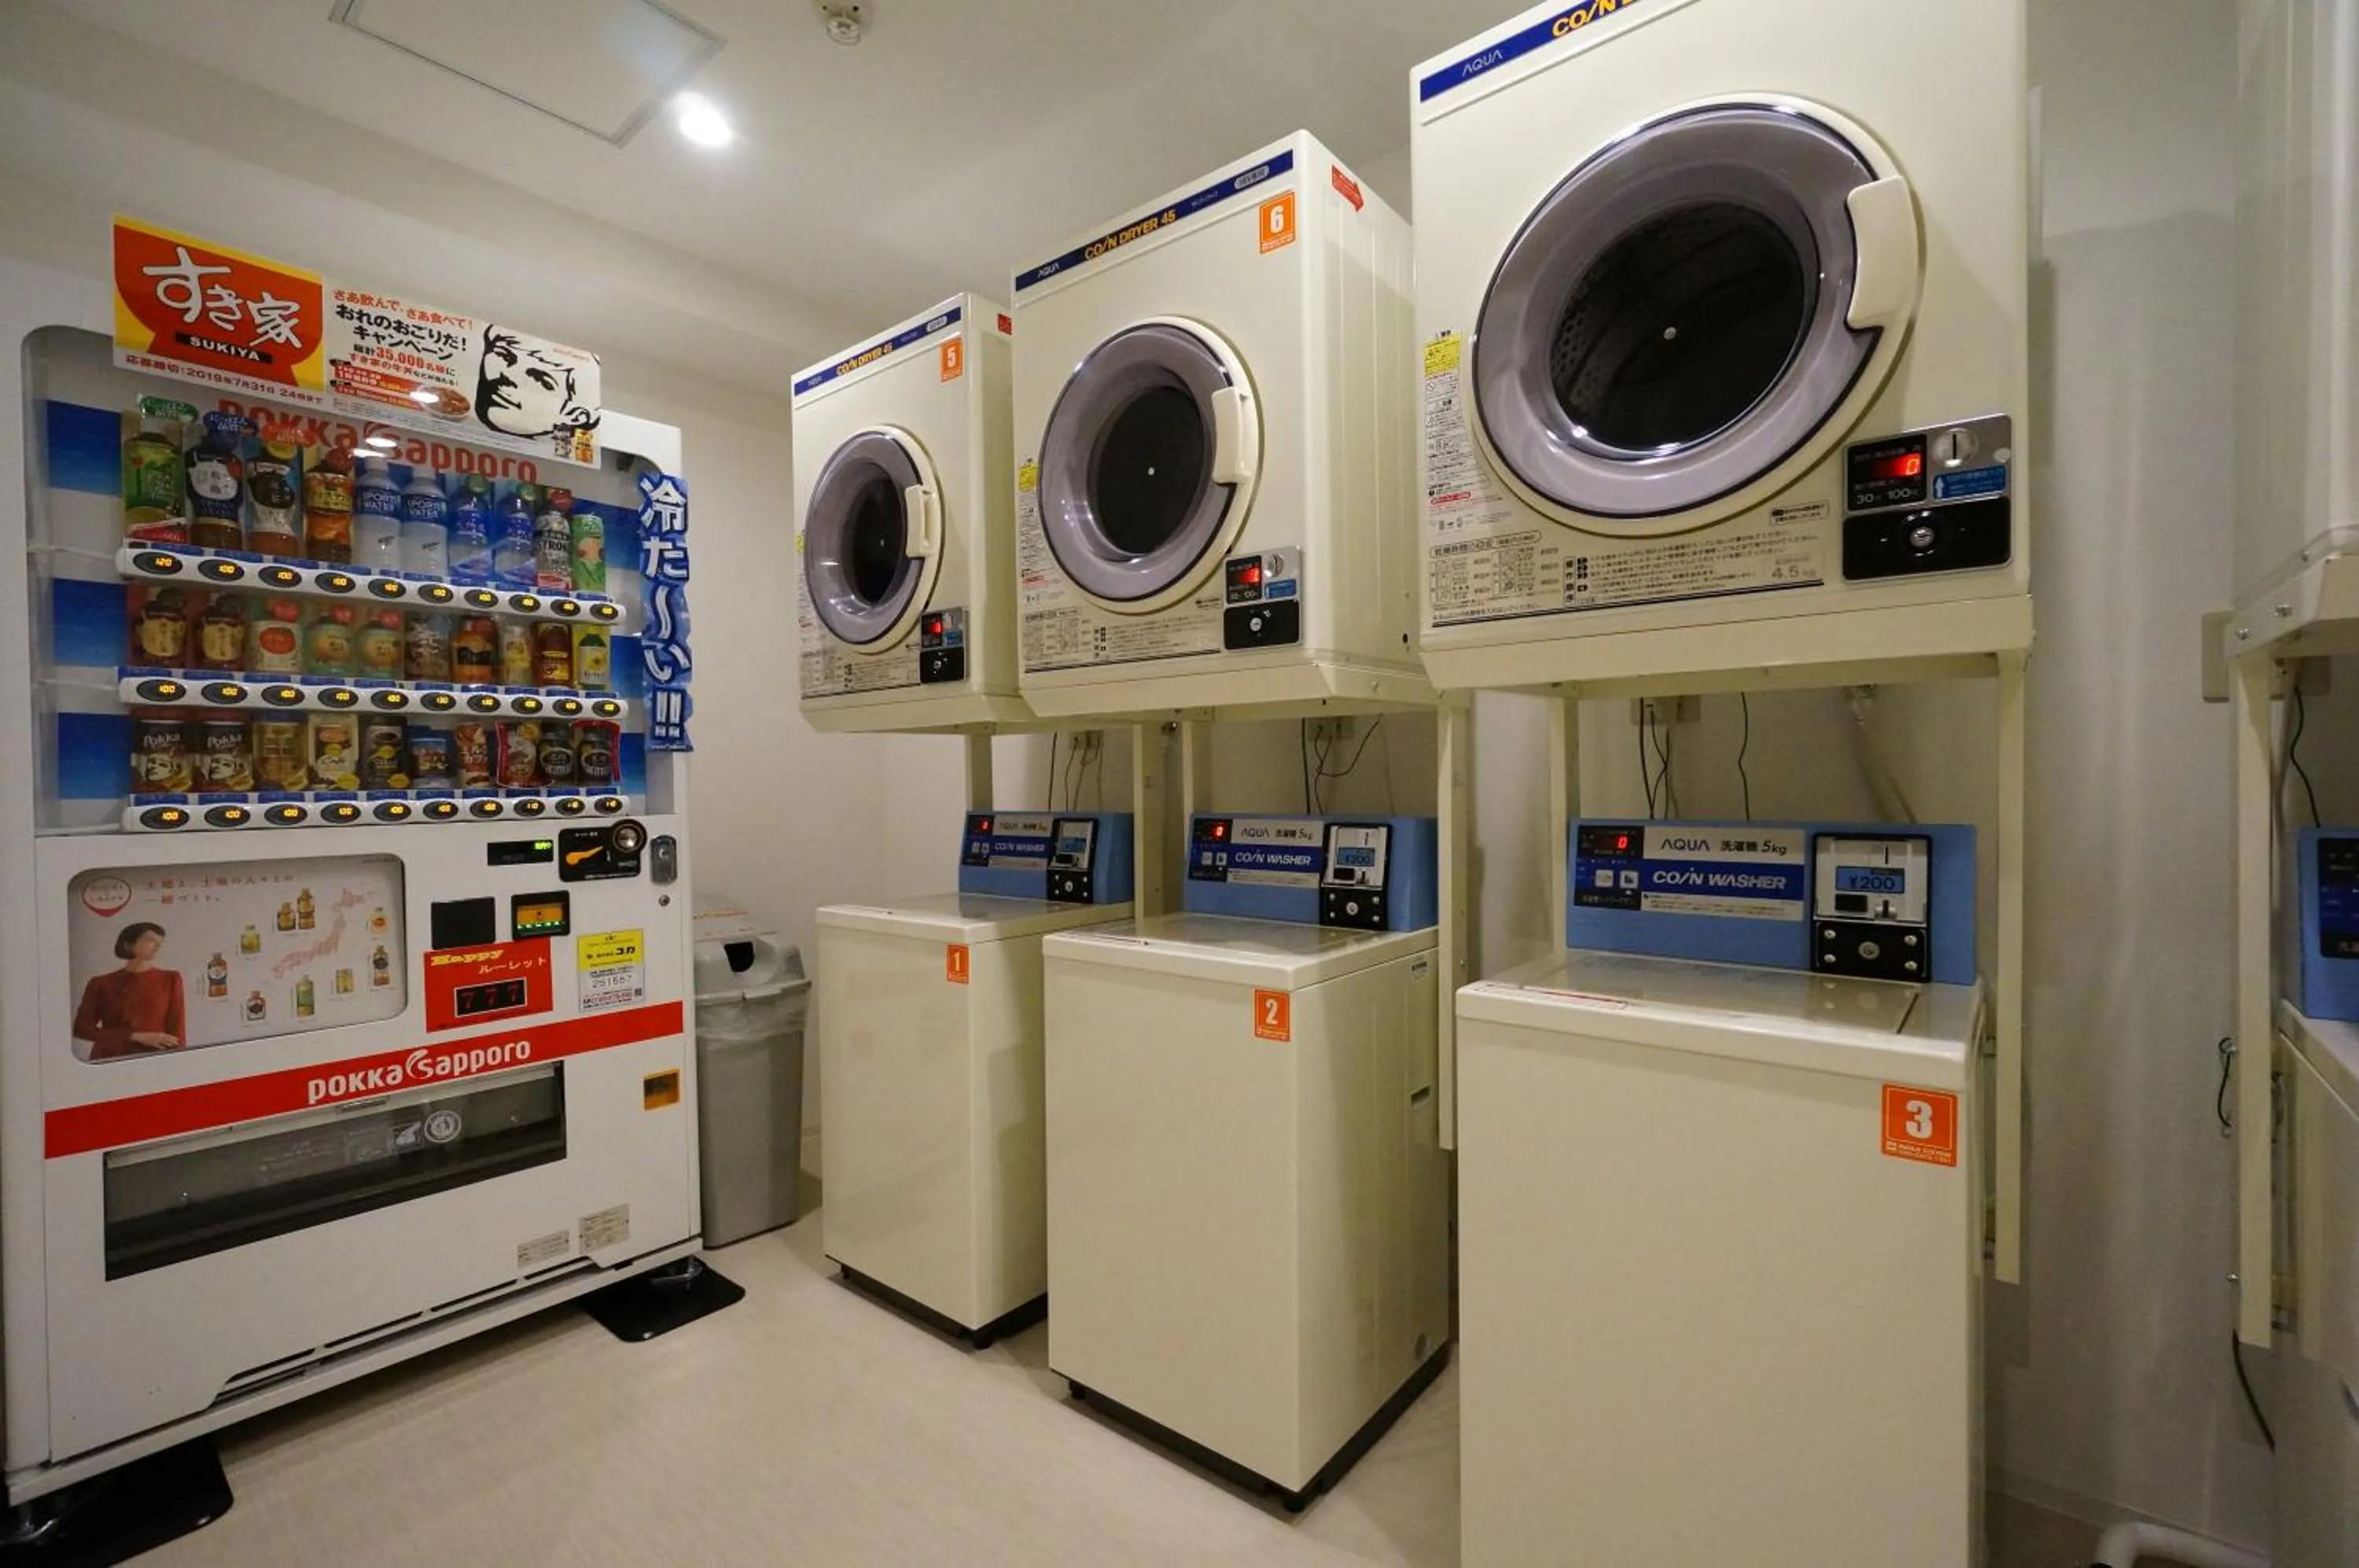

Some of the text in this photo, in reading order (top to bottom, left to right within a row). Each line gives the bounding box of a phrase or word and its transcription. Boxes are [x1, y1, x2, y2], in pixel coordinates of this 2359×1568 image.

[1462, 50, 1503, 76] AQUA
[1119, 217, 1159, 245] DRYER
[1162, 208, 1176, 224] 45
[1270, 204, 1284, 234] 6
[142, 245, 303, 350] すき家
[336, 304, 466, 352] おれのおごりだ!
[190, 336, 260, 362] SUKIYA
[353, 326, 453, 361] キャンペーン
[947, 346, 955, 367] 5
[1266, 852, 1312, 866] WASHER
[1660, 838, 1787, 856] AQUA 洗濯機 5kg
[1707, 872, 1787, 890] WASHER
[478, 955, 547, 975] ルーレット
[954, 951, 960, 972] 1
[1264, 997, 1279, 1025] 2
[1905, 1099, 1933, 1139] 3
